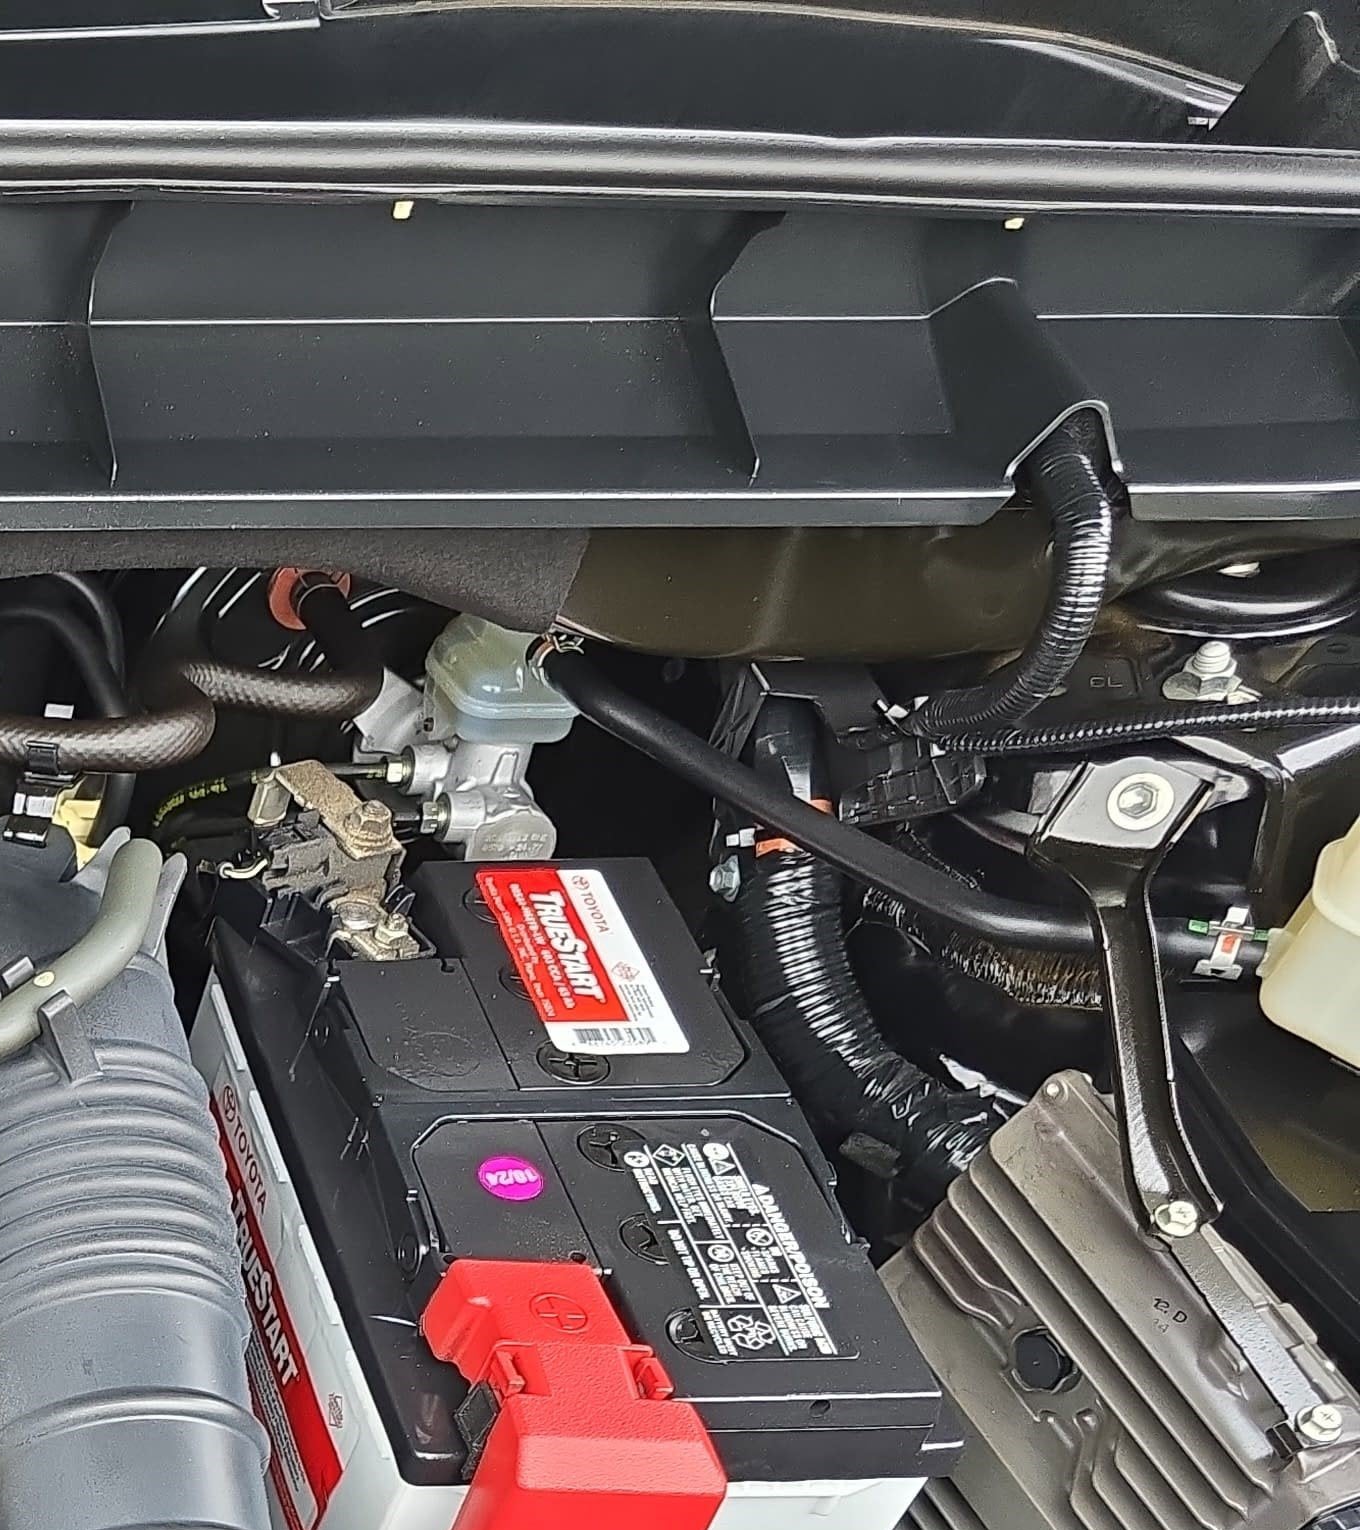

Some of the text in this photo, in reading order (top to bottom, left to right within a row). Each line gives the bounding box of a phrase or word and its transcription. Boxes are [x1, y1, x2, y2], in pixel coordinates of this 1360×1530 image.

[528, 890, 604, 998] TRUESTART
[580, 892, 611, 934] TOYOTA
[232, 1122, 268, 1216] TOYOTA
[756, 1194, 831, 1308] DANGER/POISON
